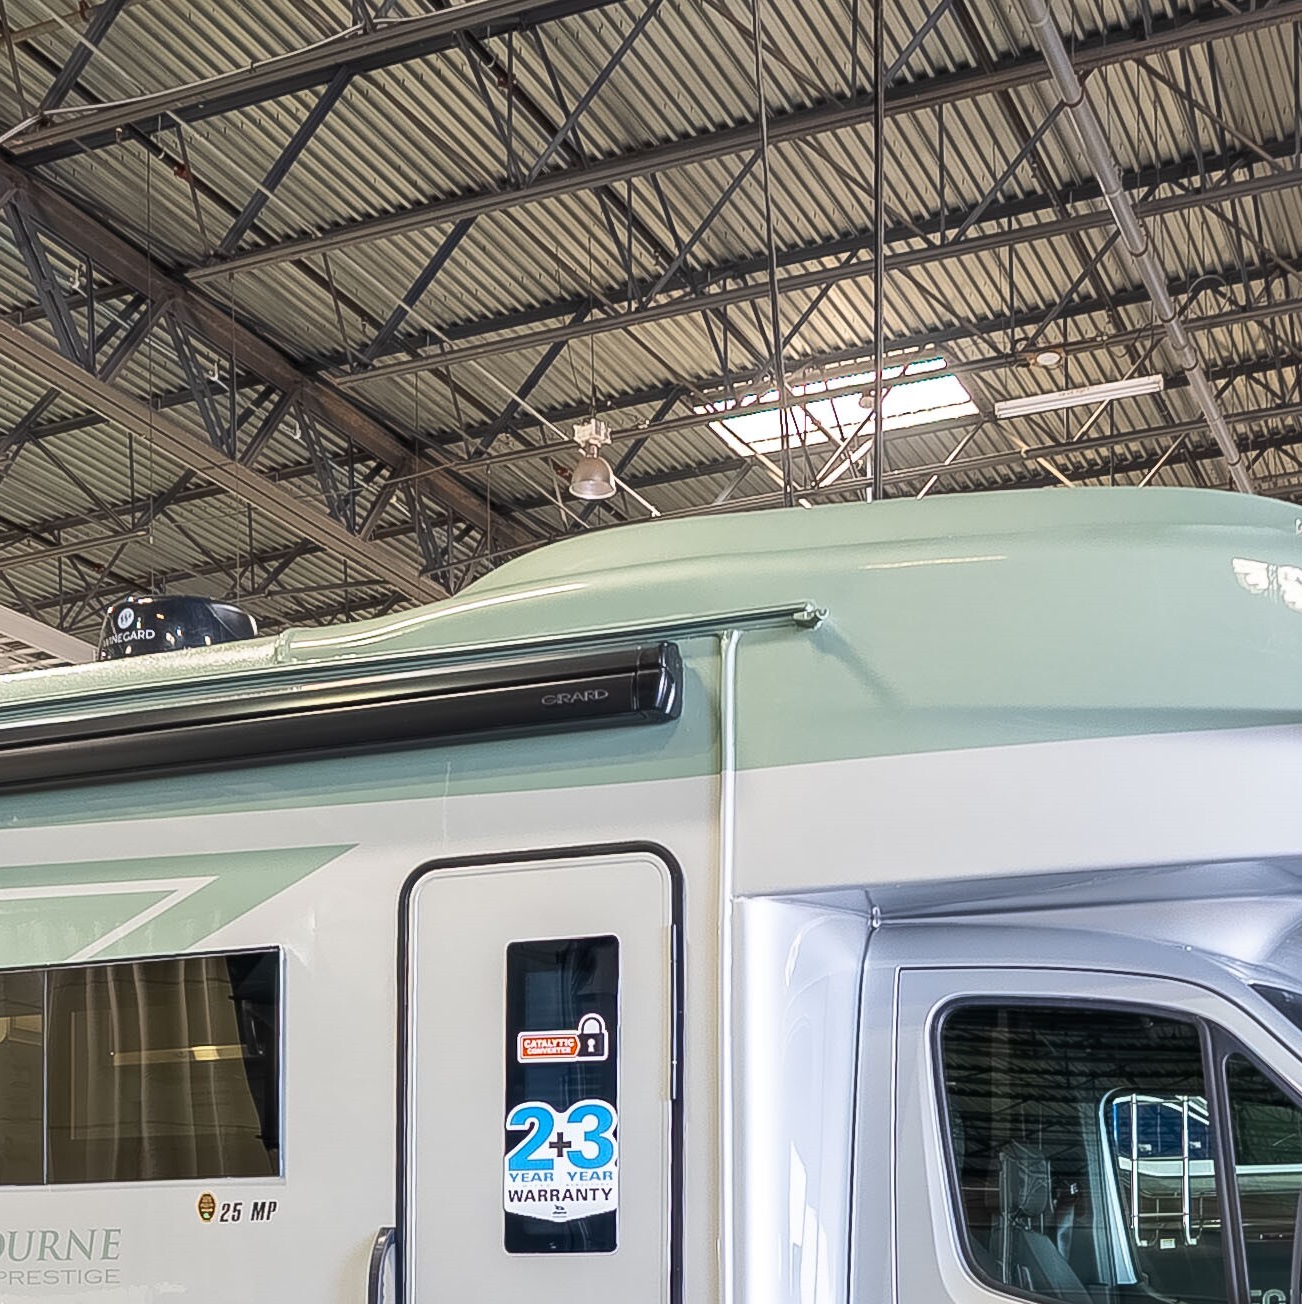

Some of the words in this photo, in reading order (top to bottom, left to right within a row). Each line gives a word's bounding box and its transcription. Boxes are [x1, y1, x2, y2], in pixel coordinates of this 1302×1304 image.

[103, 629, 156, 647] WINEGARD
[524, 1038, 575, 1049] CATALYTIC
[509, 1172, 554, 1182] YEAR
[567, 1171, 613, 1181] YEAR
[508, 1188, 612, 1202] WARRANTY
[220, 1202, 243, 1222] 25
[251, 1201, 277, 1221] MP
